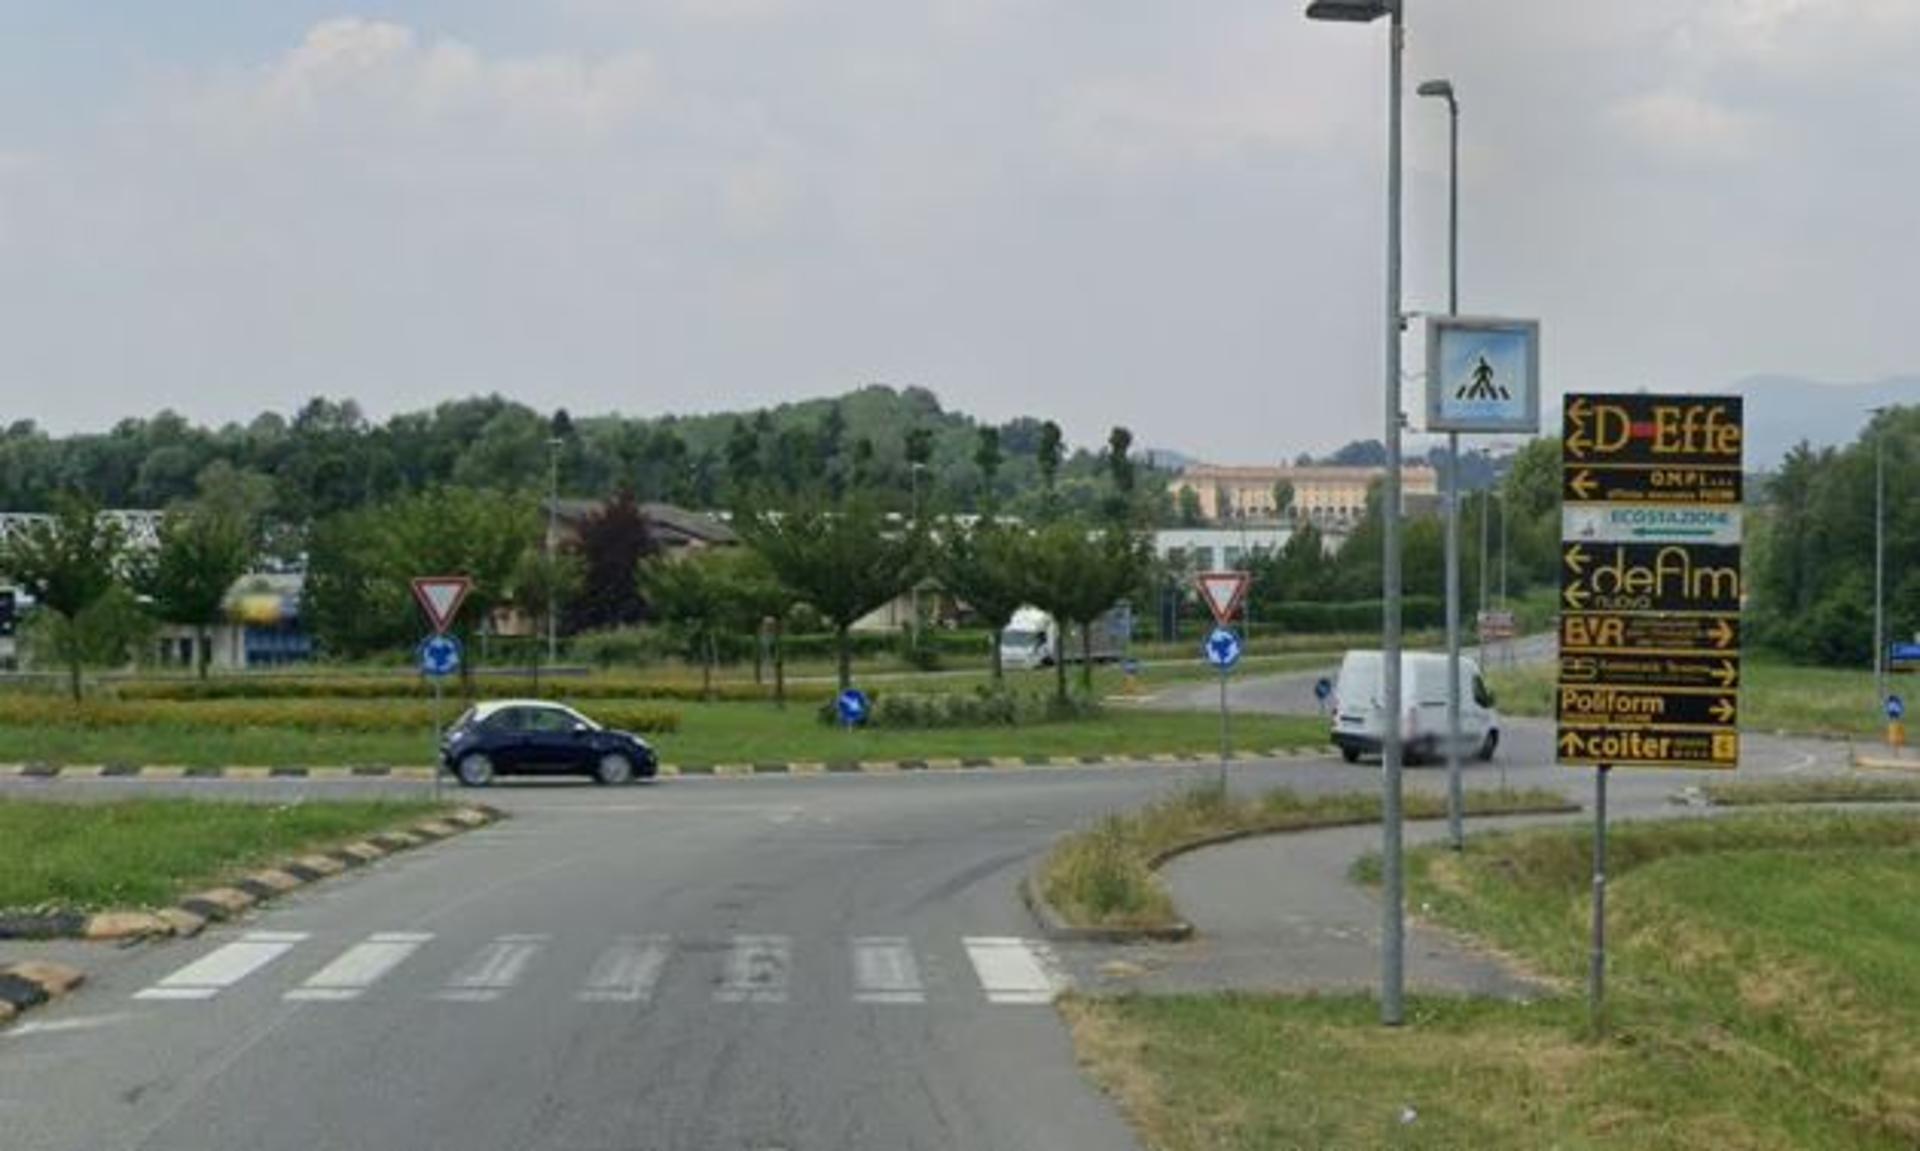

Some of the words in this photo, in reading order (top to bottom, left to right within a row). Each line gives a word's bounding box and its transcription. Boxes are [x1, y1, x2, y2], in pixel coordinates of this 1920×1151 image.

[1611, 509, 1729, 525] ECOSTAZIONE
[1562, 686, 1665, 714] Poliform
[1586, 732, 1671, 759] coiter
